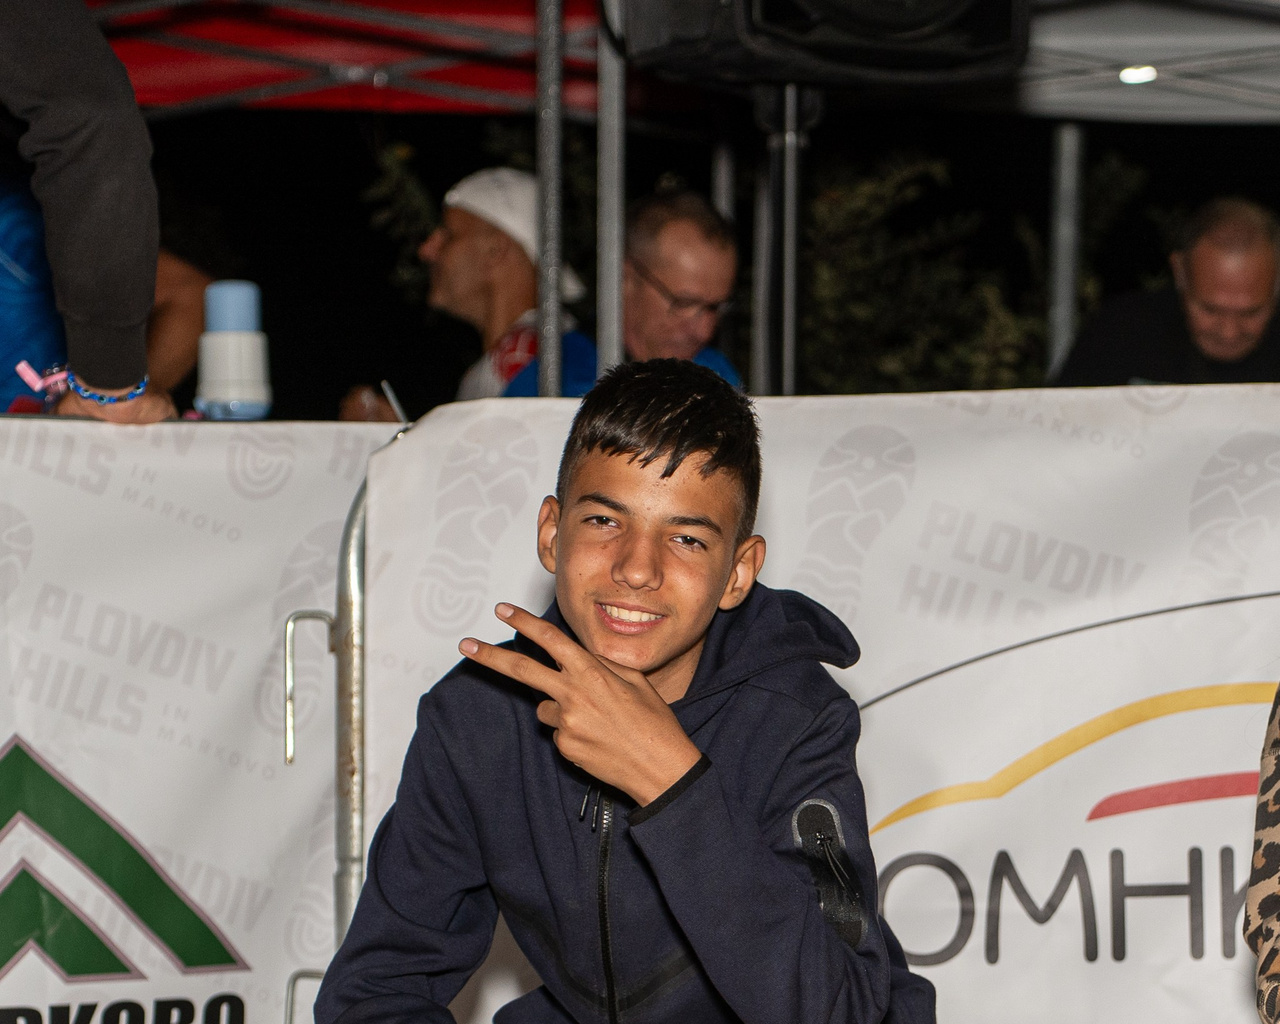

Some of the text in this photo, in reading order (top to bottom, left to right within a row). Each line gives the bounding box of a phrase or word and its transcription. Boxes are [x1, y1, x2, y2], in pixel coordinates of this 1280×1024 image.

[121, 485, 243, 544] MARKOVO
[918, 500, 1147, 600] PLOVDIV
[27, 582, 236, 694] PLOVDIV
[9, 647, 148, 737] HILLS
[157, 725, 276, 781] MARKOVO
